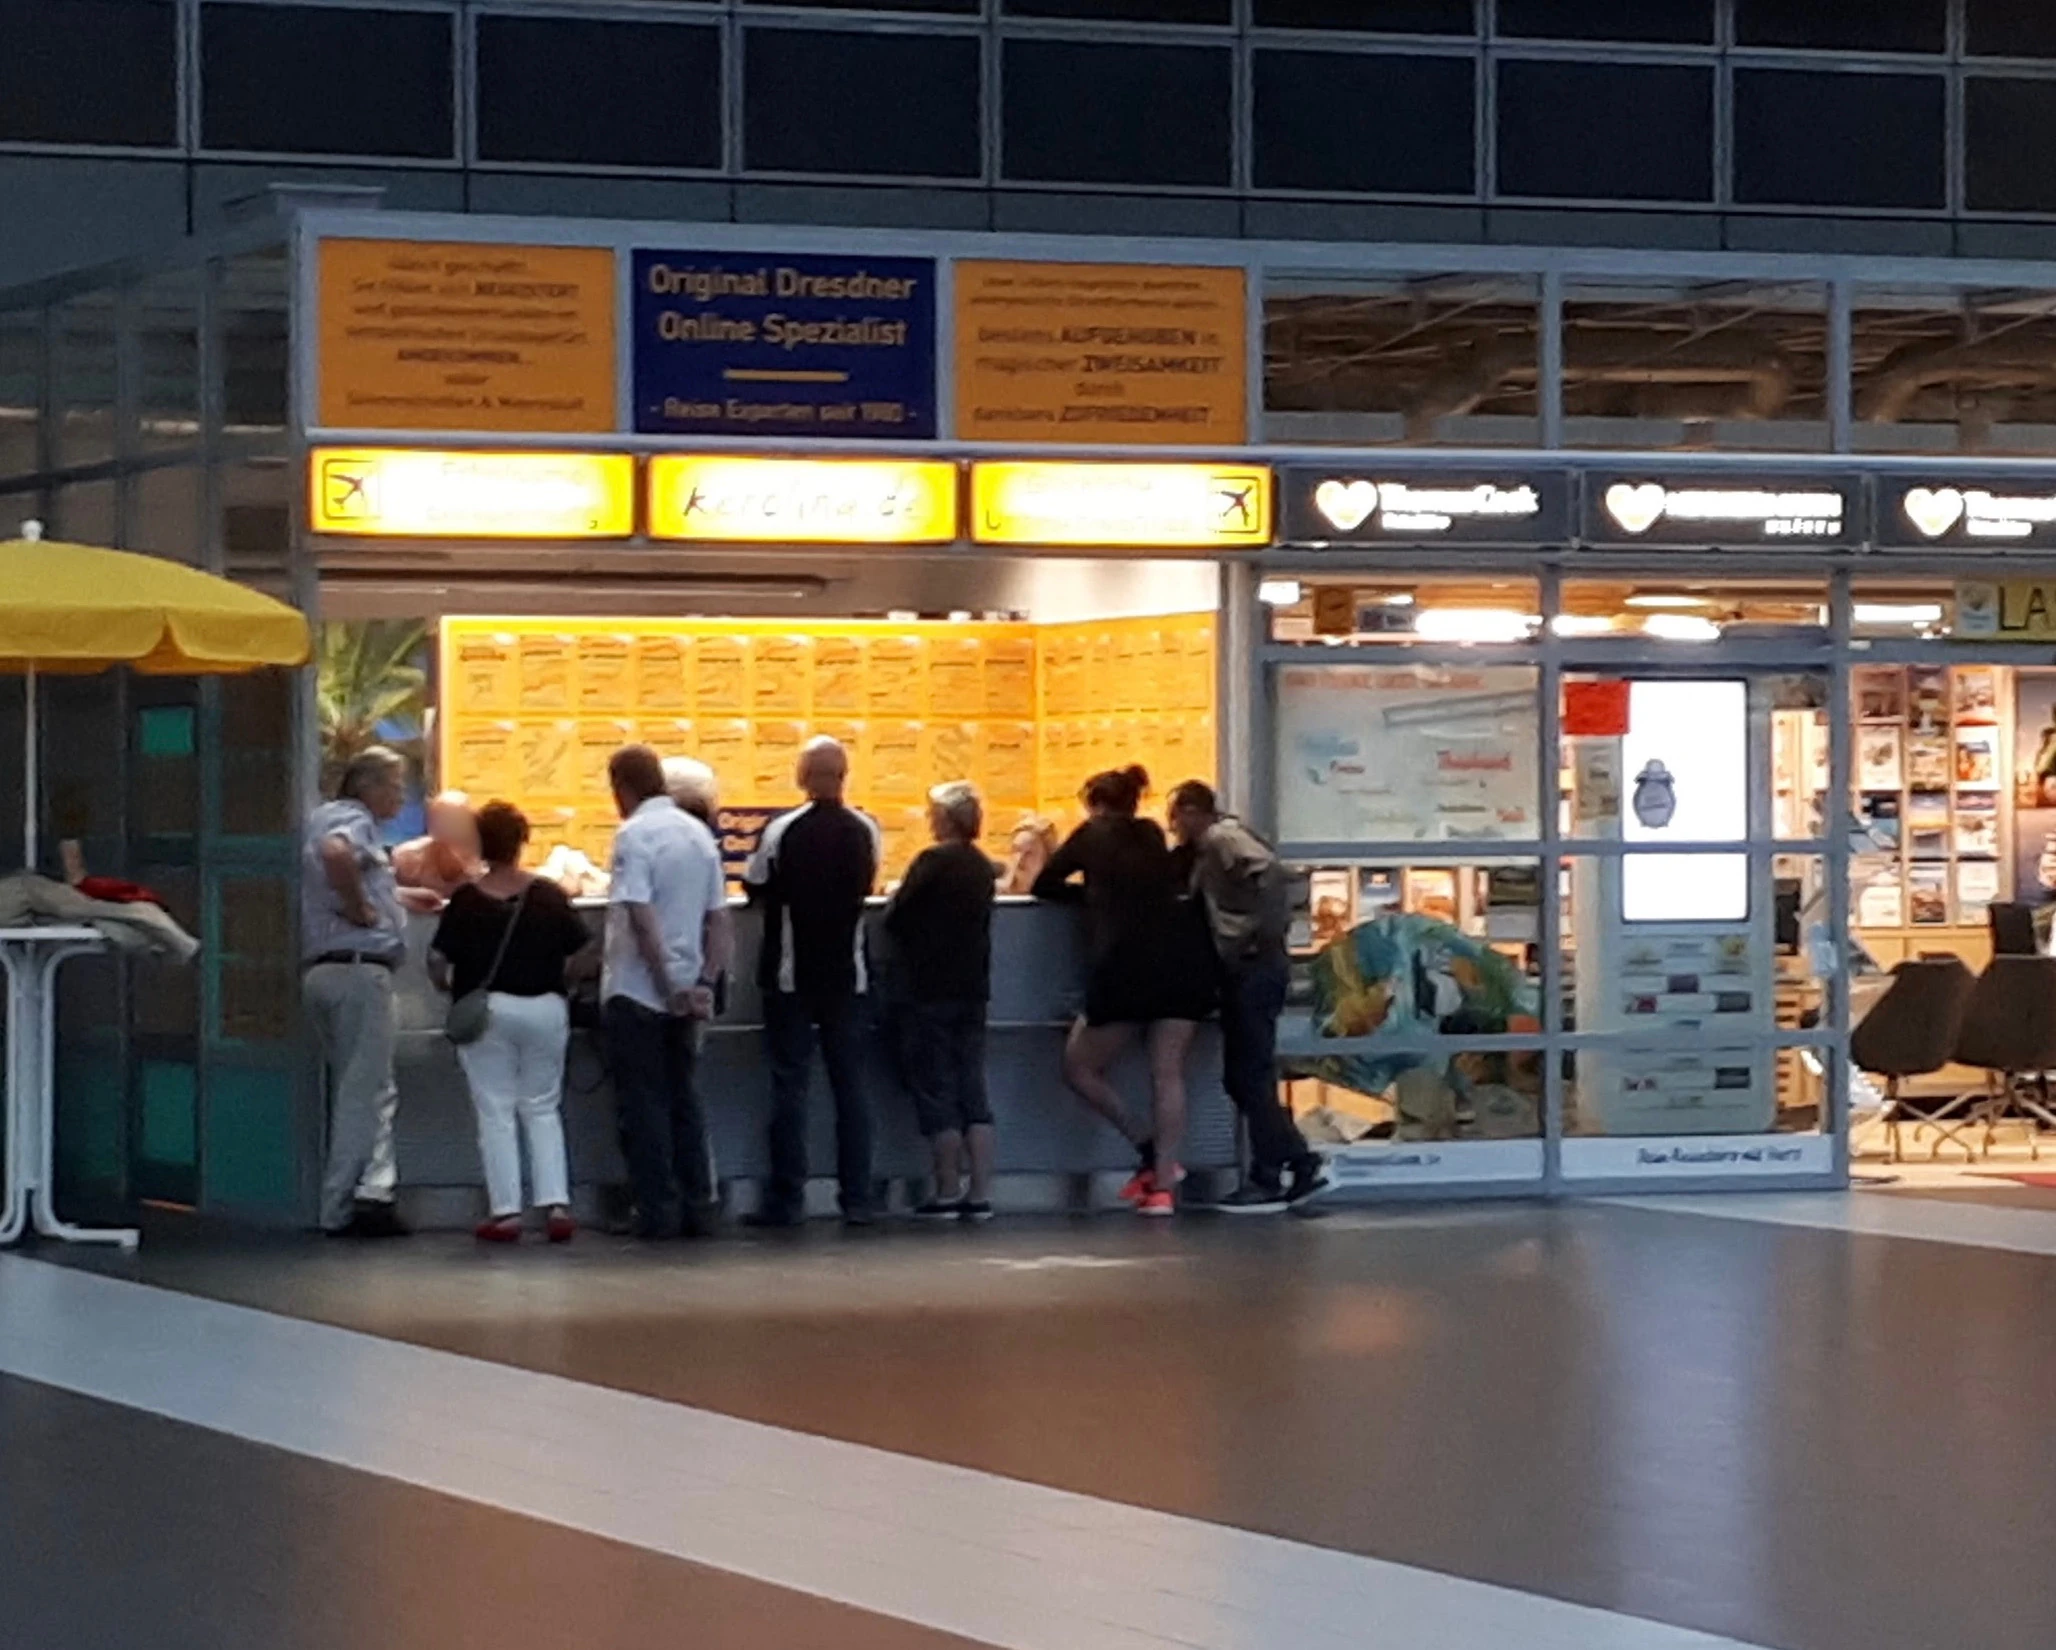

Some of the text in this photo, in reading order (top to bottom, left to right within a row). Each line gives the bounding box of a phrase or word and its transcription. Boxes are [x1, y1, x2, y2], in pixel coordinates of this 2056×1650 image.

[650, 263, 917, 301] Original Dresdner
[658, 311, 908, 350] Online Spezialist
[1998, 585, 2056, 632] LA
